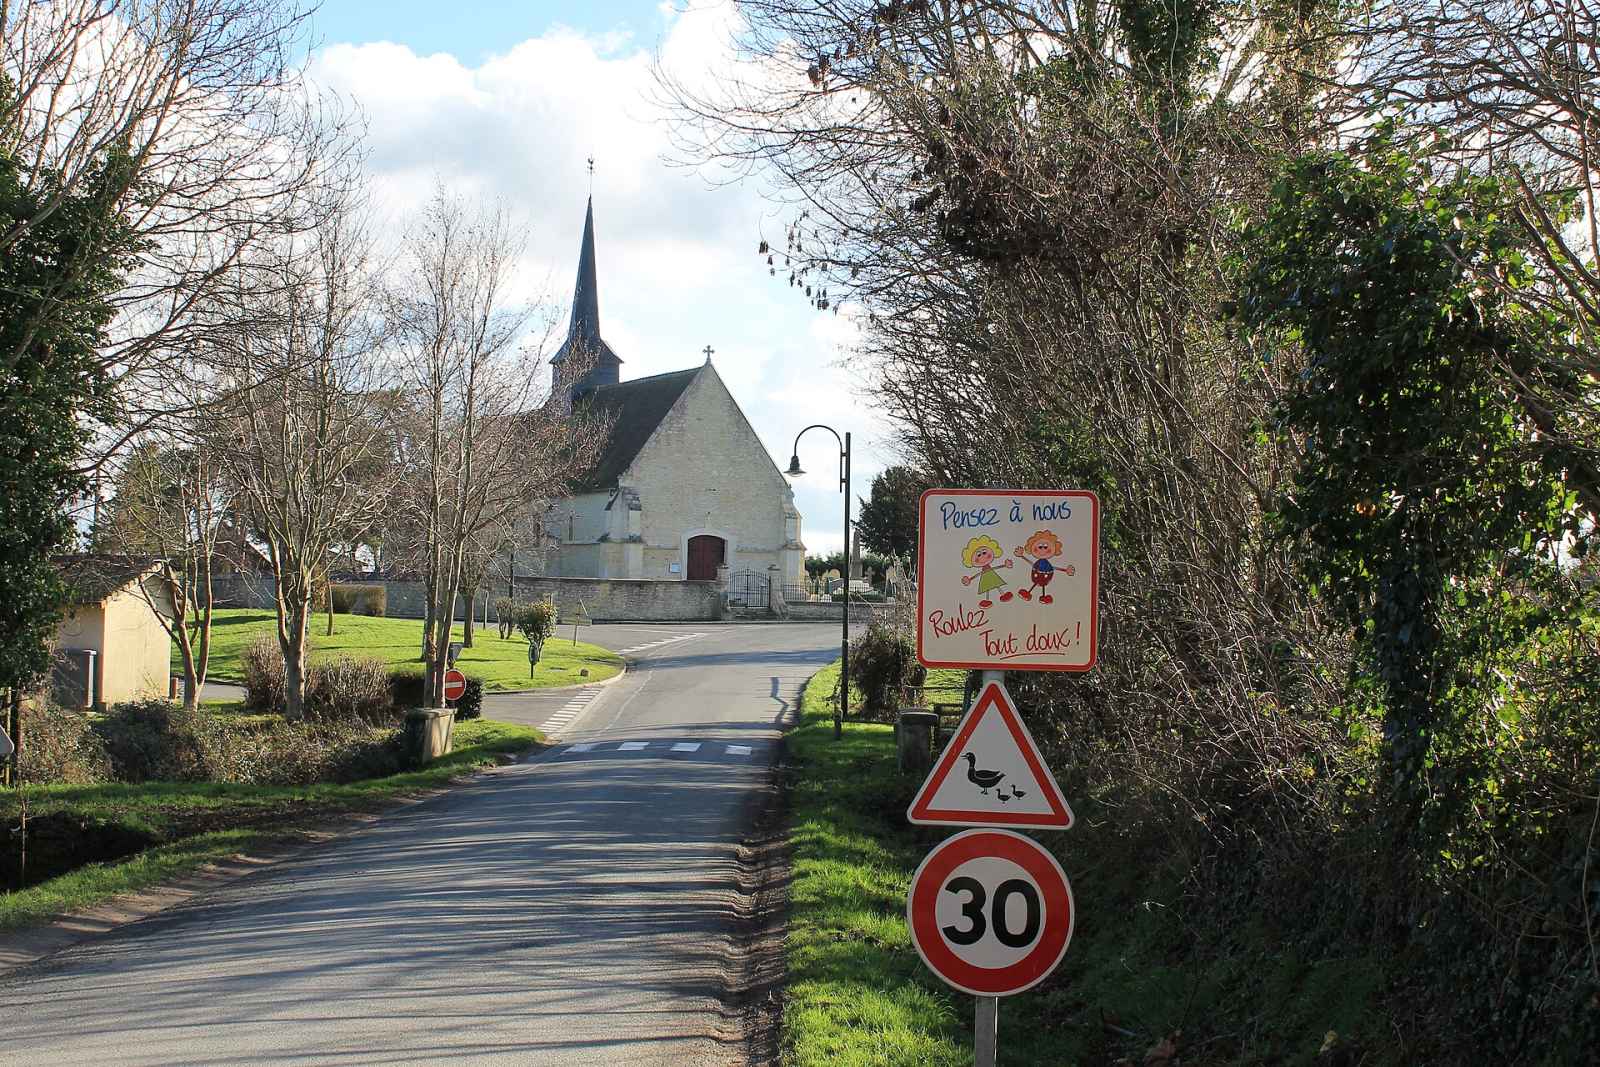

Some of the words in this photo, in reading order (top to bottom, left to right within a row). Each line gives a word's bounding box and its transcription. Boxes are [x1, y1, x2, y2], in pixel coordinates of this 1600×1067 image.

[940, 501, 1000, 530] Pensez
[1009, 500, 1023, 522] à
[1032, 501, 1072, 521] nous
[929, 604, 990, 638] Roulez
[979, 629, 1017, 657] Tout
[1026, 624, 1071, 651] doux
[942, 876, 1041, 949] 30
